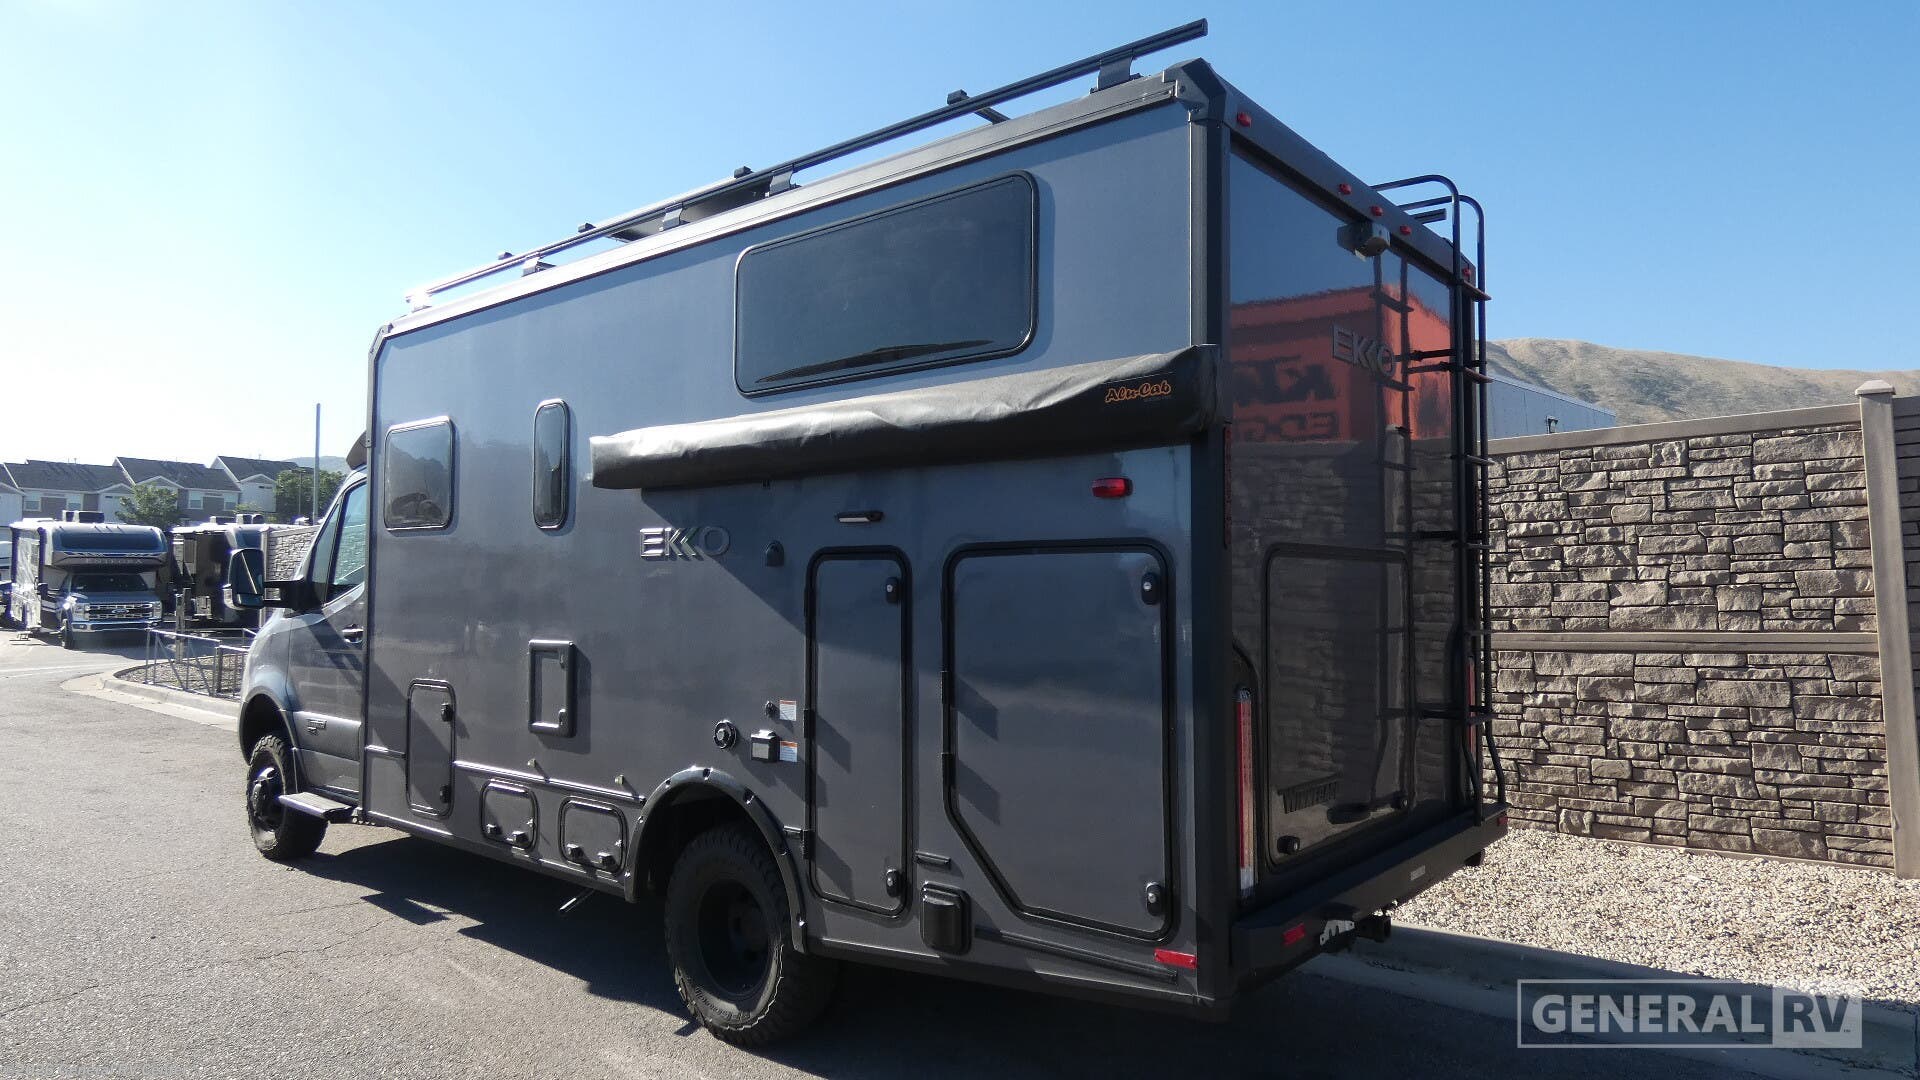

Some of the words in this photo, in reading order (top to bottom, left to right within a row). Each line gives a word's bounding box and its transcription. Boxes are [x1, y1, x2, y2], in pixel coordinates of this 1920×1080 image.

[1332, 323, 1396, 380] EKKO
[1105, 379, 1171, 403] Alu-Cab
[640, 526, 730, 559] EKKO
